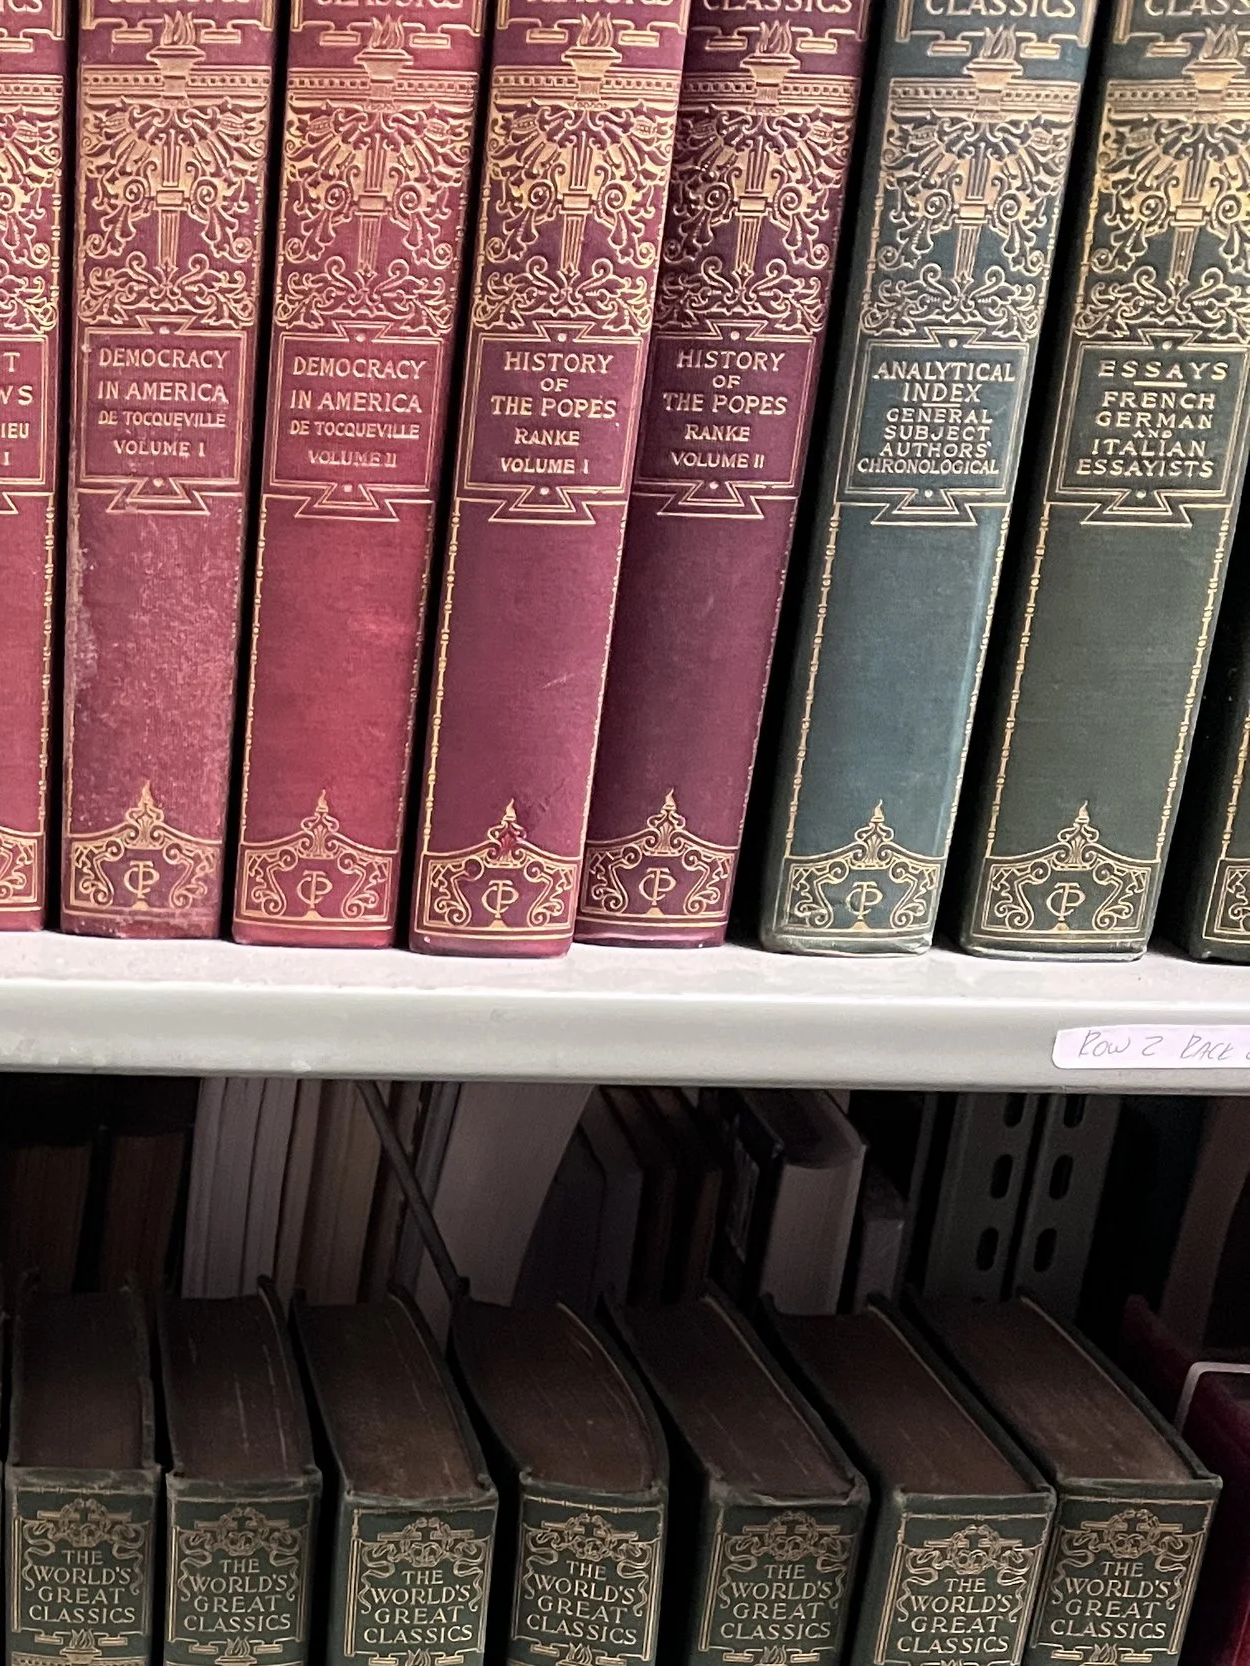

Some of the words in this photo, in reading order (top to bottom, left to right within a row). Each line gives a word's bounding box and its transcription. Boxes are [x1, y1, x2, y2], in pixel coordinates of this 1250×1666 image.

[99, 348, 229, 370] DEMOCRACY
[293, 356, 427, 380] DEMOCRACY
[504, 351, 614, 374] HISTORY
[677, 349, 785, 372] HISTORY
[872, 361, 1015, 383] ANALYTICAL
[1098, 360, 1229, 381] ESSAYS
[98, 380, 119, 399] IN
[125, 382, 229, 403] AMERICA
[540, 378, 569, 392] OF
[712, 375, 741, 389] OF
[290, 390, 311, 410] IN
[318, 392, 423, 414] AMERICA
[903, 384, 981, 404] INDEX
[1102, 391, 1215, 411] FRENCH
[491, 396, 532, 417] THE
[541, 398, 617, 419] POPES
[663, 393, 703, 412] THE
[712, 394, 788, 416] POPES
[98, 410, 118, 425] DE
[122, 410, 226, 428] TOCQUEVILLE
[887, 408, 993, 424] GENERAL
[1096, 411, 1213, 429] GERMAN
[290, 420, 310, 436] DE
[314, 421, 420, 440] TOCQUEVILLE
[514, 428, 580, 447] RANKE
[685, 424, 750, 442] RANKE
[884, 425, 991, 441] SUBJECT
[1133, 429, 1172, 439] AND
[113, 440, 190, 457] VOLUME
[199, 441, 205, 457] I
[1091, 438, 1205, 457] ITALIAN
[4, 452, 10, 467] I
[308, 450, 380, 467] VOLUME
[385, 452, 397, 468] II
[500, 458, 575, 474] VOLUME
[583, 459, 589, 474] I
[671, 452, 749, 469] VOLUME
[753, 454, 764, 469] II
[858, 458, 999, 475] CHRONOLOGICAL
[1077, 459, 1213, 478] ESSAYISTS
